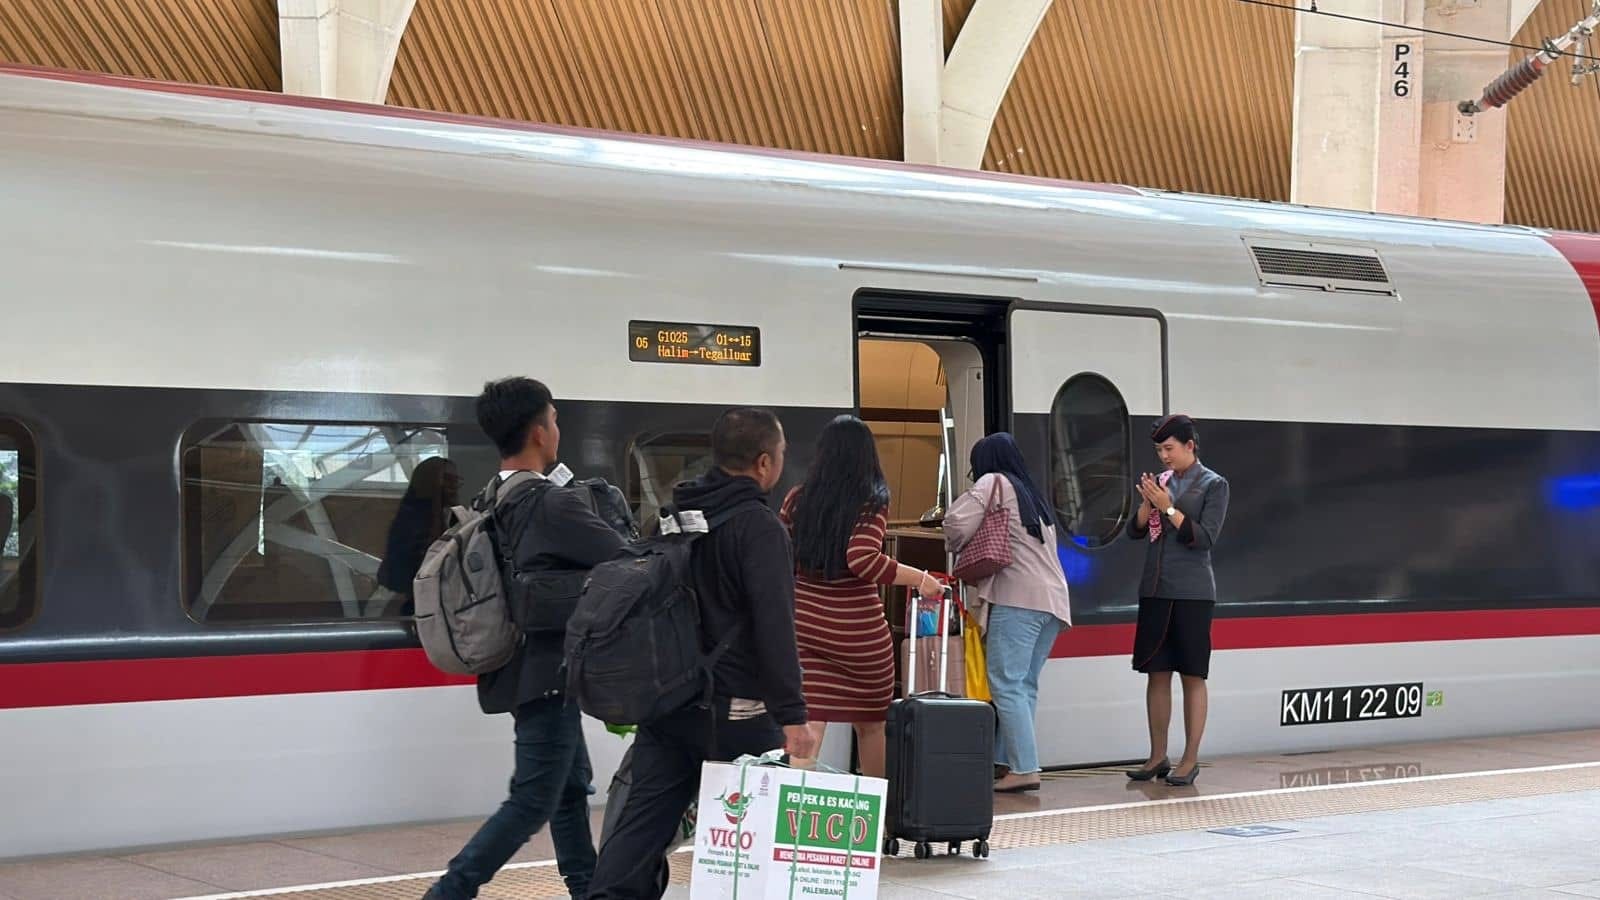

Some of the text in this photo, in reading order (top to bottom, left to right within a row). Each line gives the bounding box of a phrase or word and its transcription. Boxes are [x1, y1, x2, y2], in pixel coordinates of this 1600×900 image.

[1394, 43, 1410, 97] P46
[635, 336, 649, 349] 05
[657, 331, 688, 343] G1025
[1359, 688, 1388, 718] 22
[1395, 686, 1421, 715] 09
[819, 796, 825, 806] &
[826, 797, 837, 808] ES
[786, 808, 868, 845] VICO
